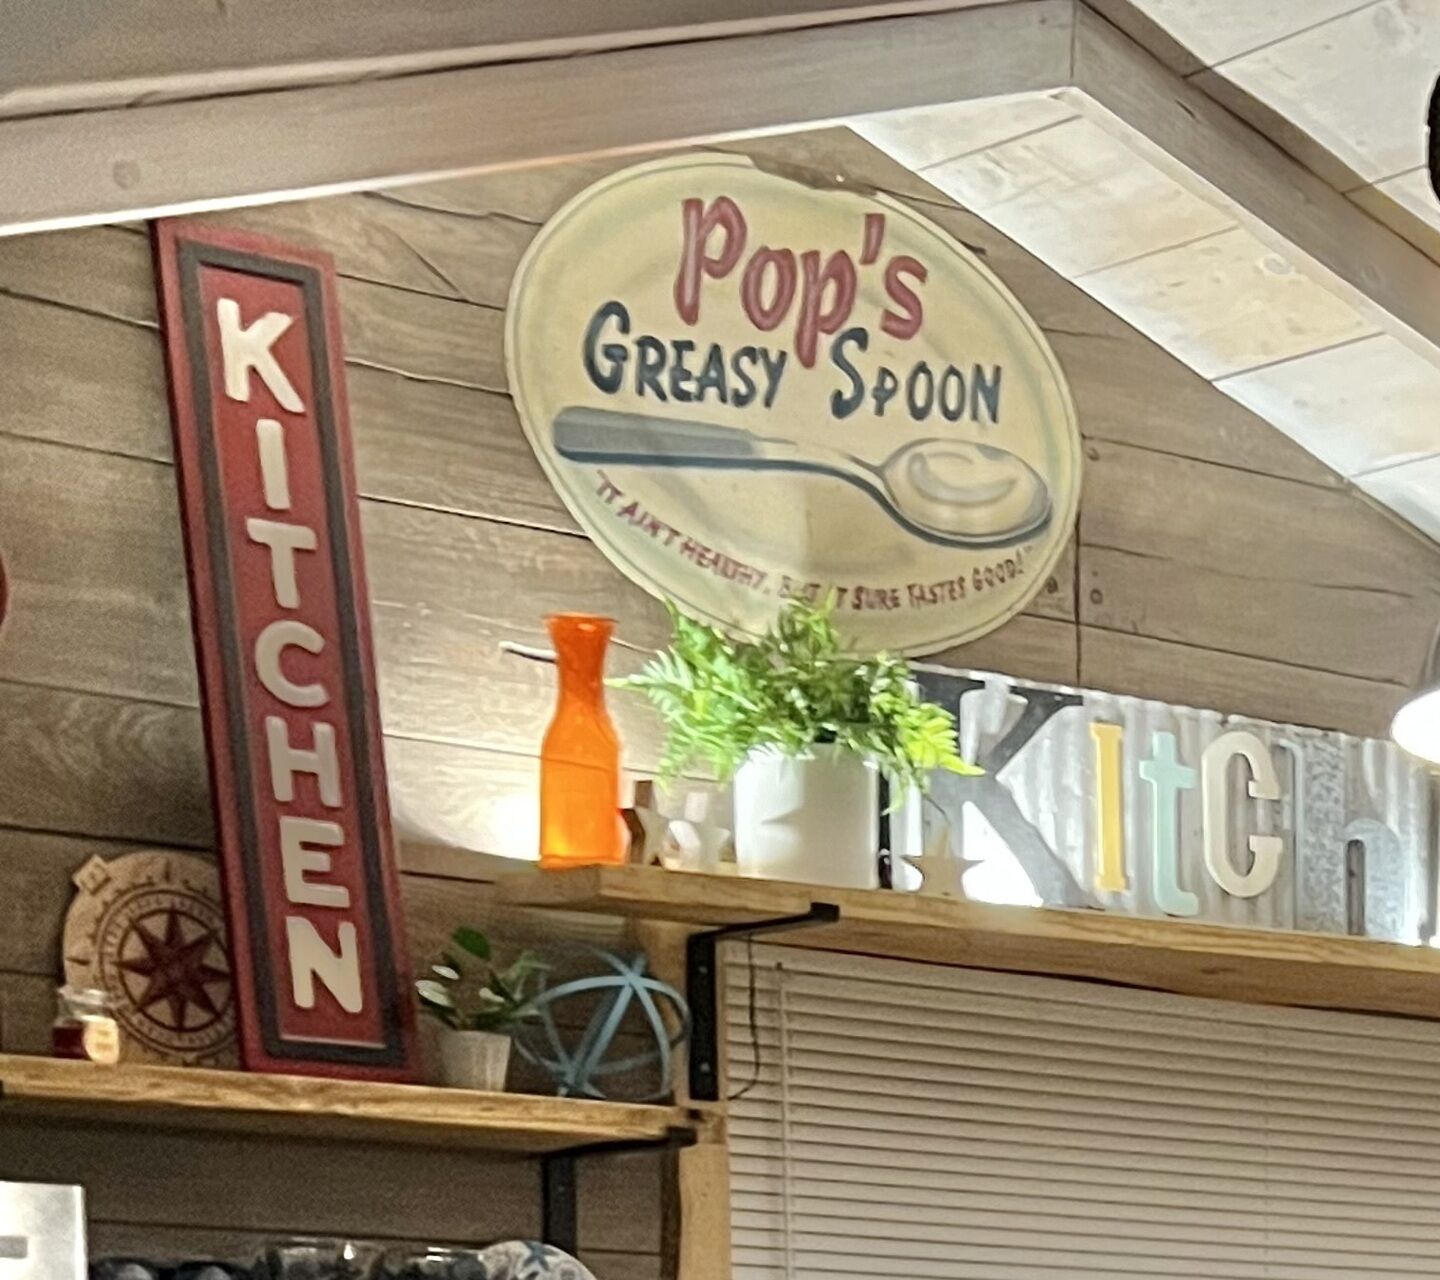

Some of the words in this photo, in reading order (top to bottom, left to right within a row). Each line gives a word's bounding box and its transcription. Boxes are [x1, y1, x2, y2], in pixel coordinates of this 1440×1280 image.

[673, 195, 928, 369] Pop's
[216, 297, 364, 1015] KITCHEN
[852, 585, 901, 611] SURE
[906, 575, 967, 610] TASTES
